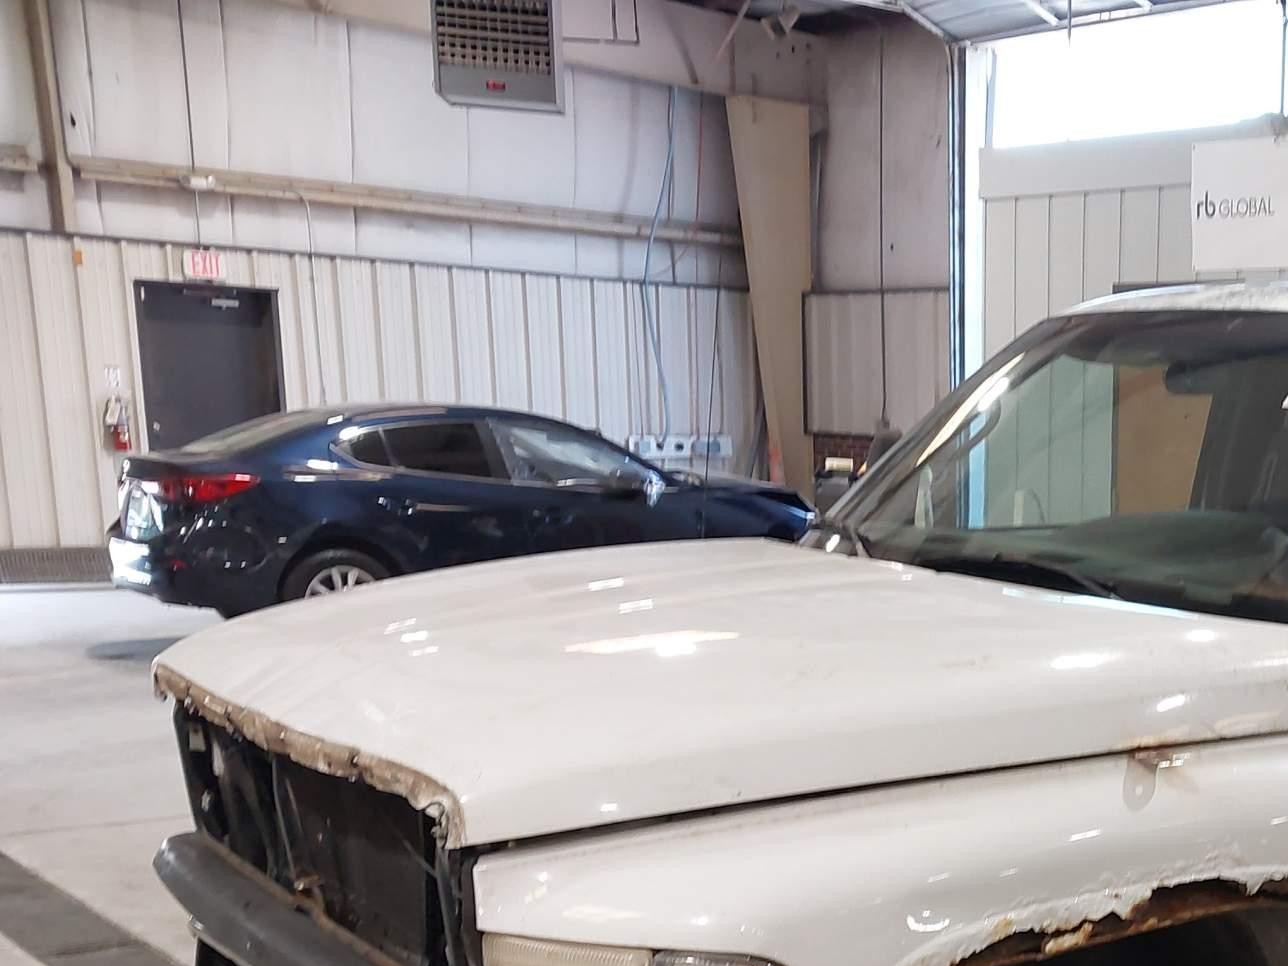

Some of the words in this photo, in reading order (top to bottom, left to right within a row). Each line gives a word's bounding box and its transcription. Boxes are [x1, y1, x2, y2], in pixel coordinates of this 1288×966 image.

[1196, 190, 1216, 219] rb
[1218, 195, 1276, 218] GLOBAL
[191, 251, 220, 277] EXIT
